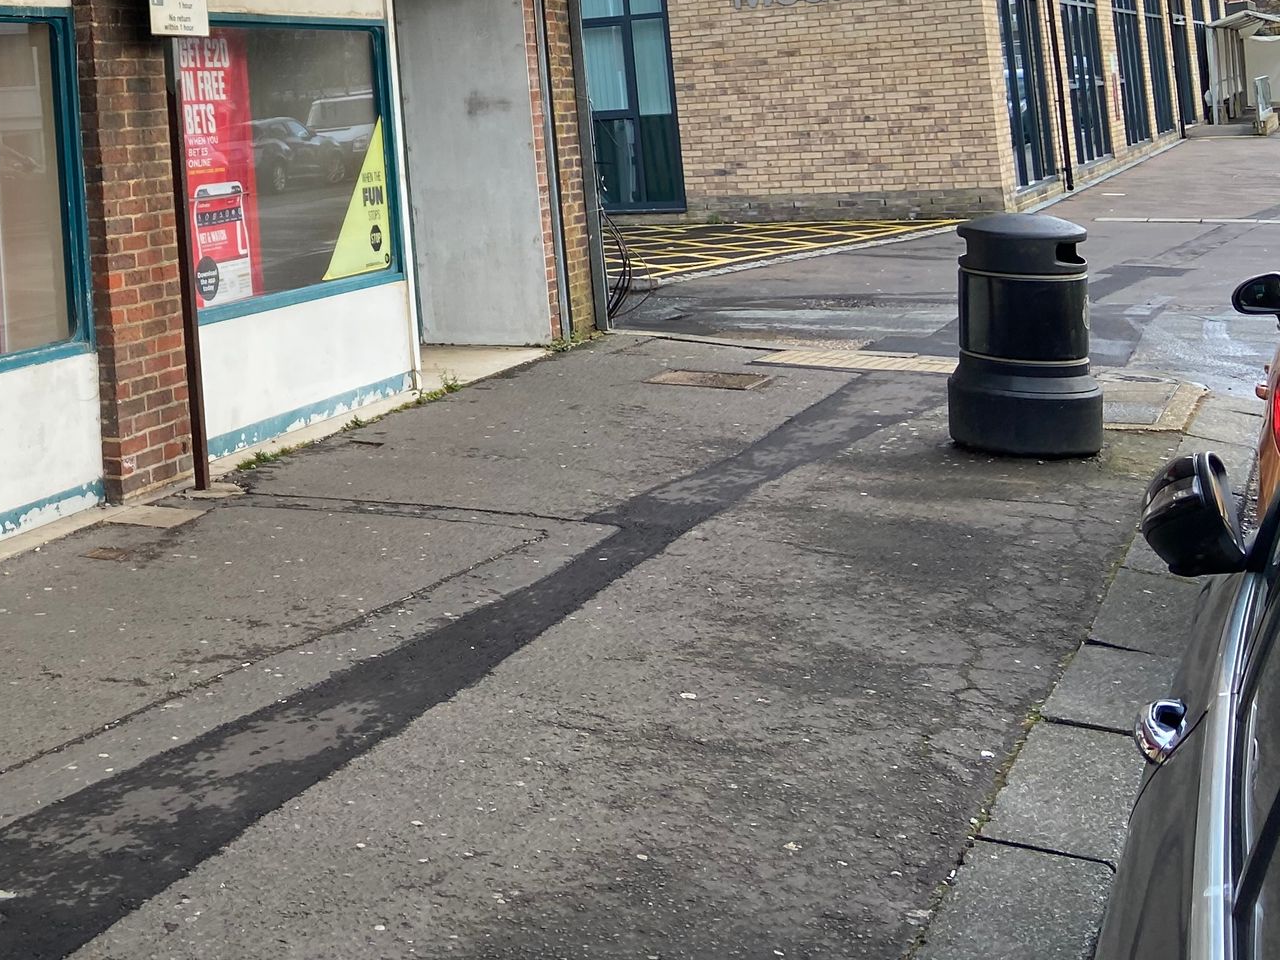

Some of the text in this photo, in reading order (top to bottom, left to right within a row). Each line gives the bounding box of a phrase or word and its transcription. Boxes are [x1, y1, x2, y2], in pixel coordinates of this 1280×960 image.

[180, 38, 230, 68] GET £20
[181, 70, 226, 101] IN FREE
[184, 103, 216, 135] BETS
[188, 136, 218, 145] WHEN YOU
[189, 148, 200, 156] BET
[362, 186, 384, 207] FUN
